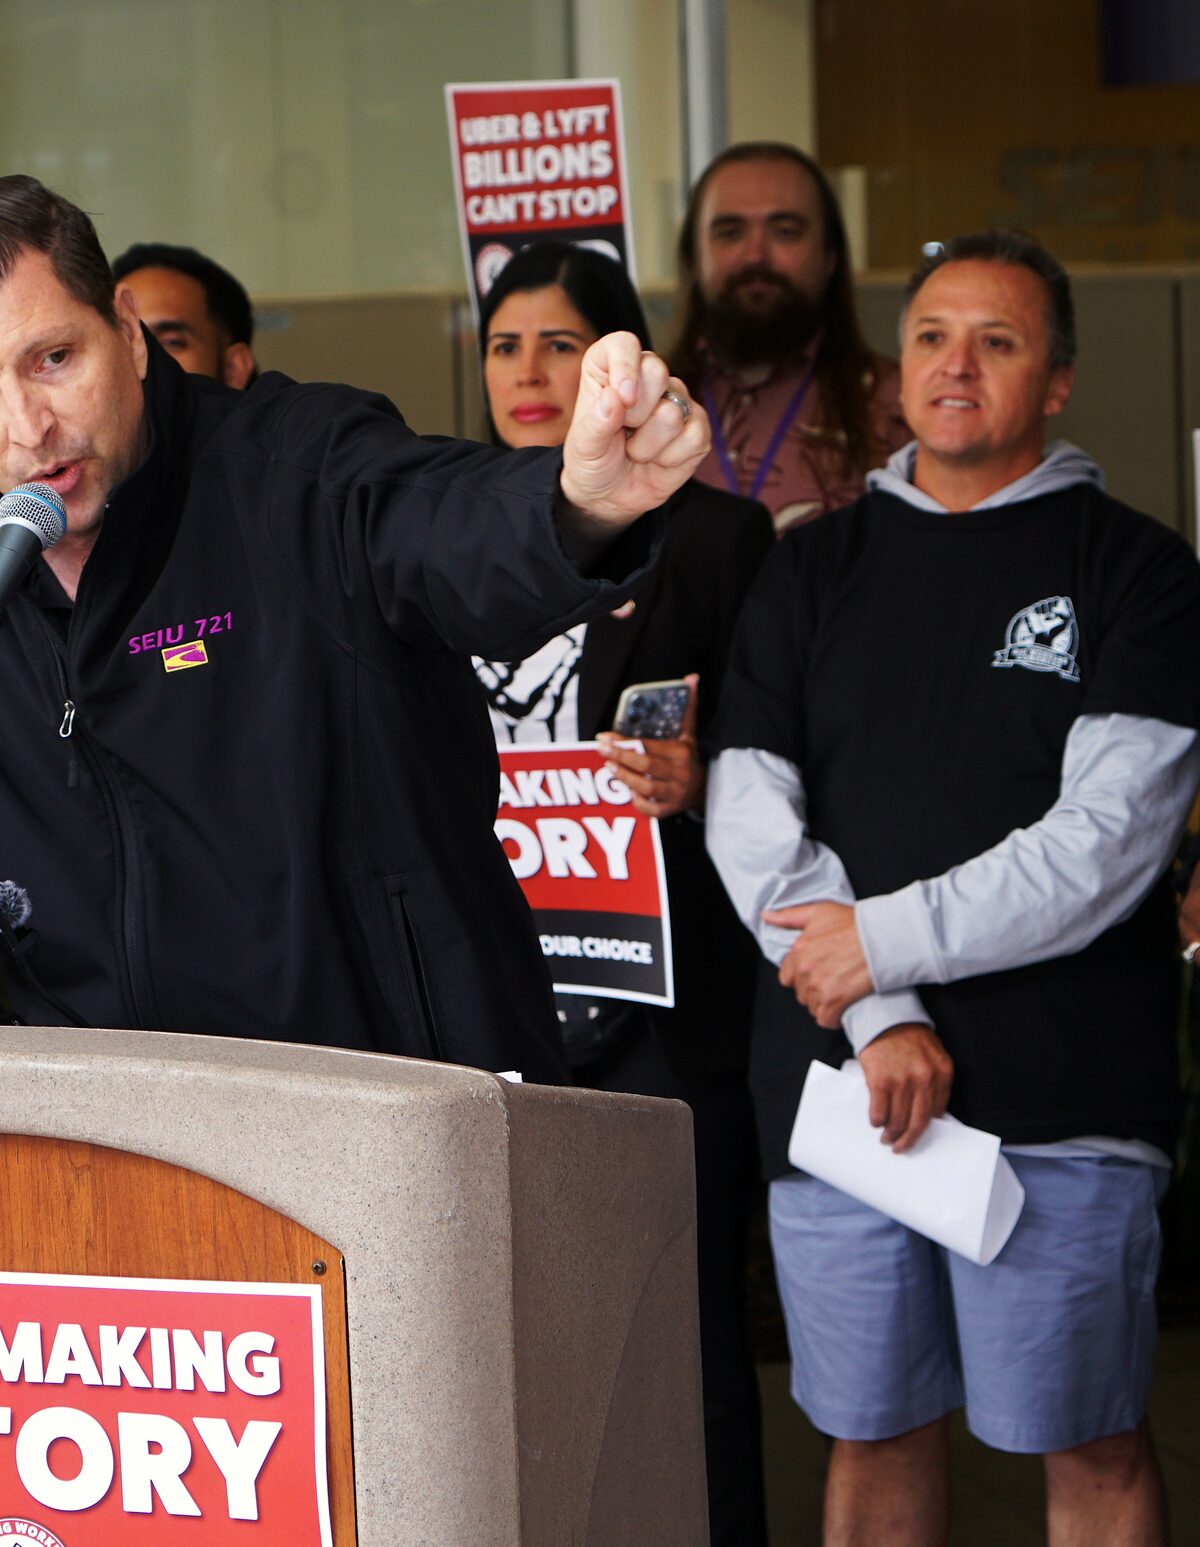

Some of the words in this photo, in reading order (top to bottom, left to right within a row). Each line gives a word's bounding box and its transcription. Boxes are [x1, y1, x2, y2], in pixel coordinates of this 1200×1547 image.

[461, 115, 519, 144] UBER
[521, 111, 542, 140] &
[545, 106, 609, 137] LYFT
[464, 141, 612, 187] BILLIONS
[467, 193, 536, 224] CAN'T
[540, 186, 617, 219] STOP
[128, 624, 183, 655] SEIU
[194, 611, 232, 638] 721
[539, 934, 583, 957] OUR
[582, 937, 653, 965] CHOICE
